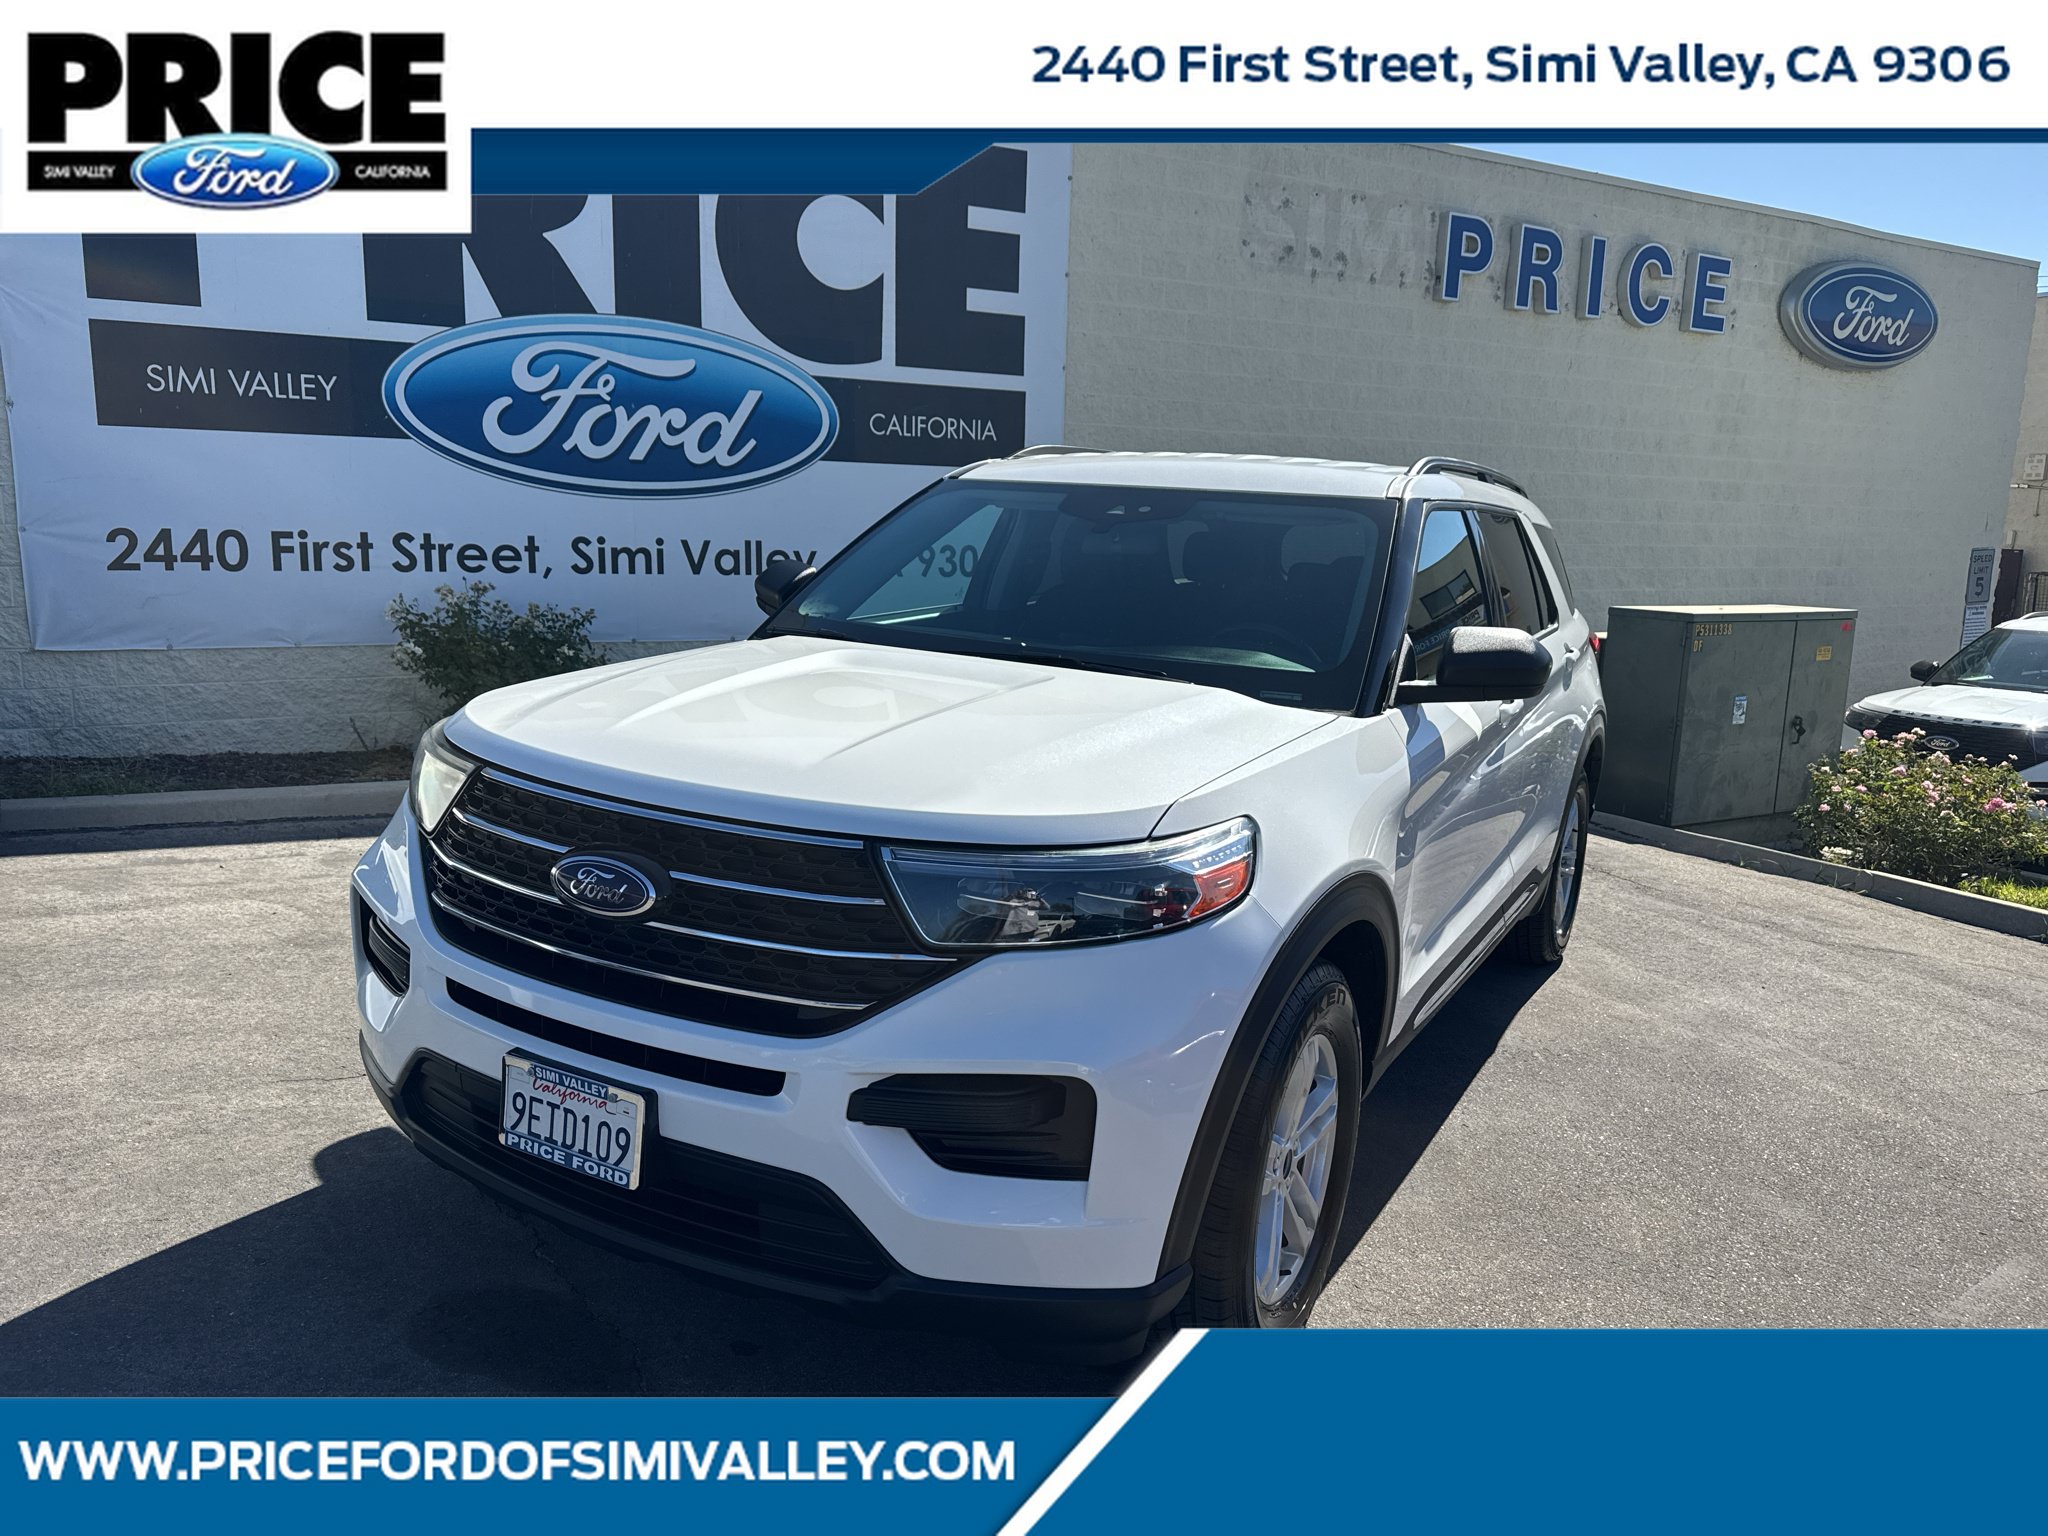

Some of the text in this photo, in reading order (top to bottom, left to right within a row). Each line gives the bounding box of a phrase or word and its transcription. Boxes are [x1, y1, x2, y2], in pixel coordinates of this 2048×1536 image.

[1438, 211, 1733, 335] PRICE
[1832, 284, 1917, 348] Ford
[146, 363, 337, 402] SIMI VALLEY
[482, 341, 763, 467] Ford
[869, 413, 997, 441] CALIFORNIA
[105, 527, 249, 573] 2440
[270, 529, 374, 573] First
[391, 531, 553, 580] Street,
[570, 535, 665, 576] Simi
[1973, 554, 1993, 563] SPEED
[1973, 565, 1990, 575] LIMIT
[1974, 576, 1985, 597] 5
[1930, 739, 1951, 748] Ford
[569, 866, 628, 905] Ford
[532, 1077, 616, 1116] California
[534, 1066, 608, 1098] SIMI VALLEY
[510, 1091, 631, 1168] 9EID109
[506, 1132, 629, 1186] PRICE FORD
